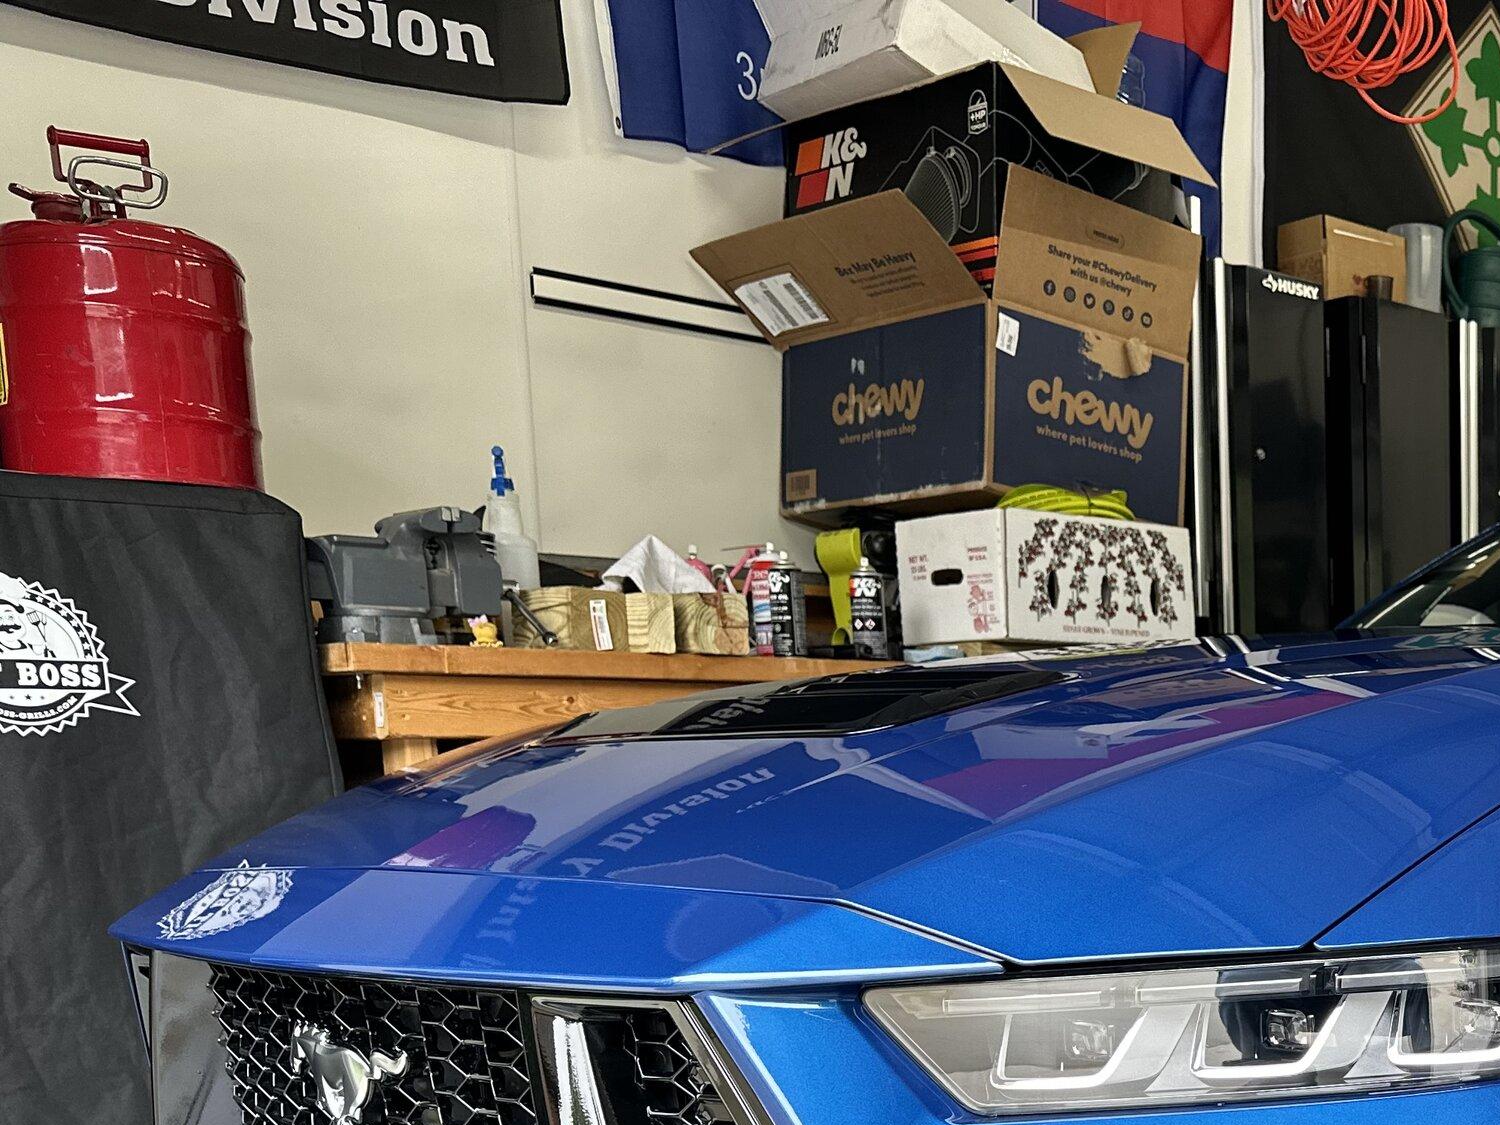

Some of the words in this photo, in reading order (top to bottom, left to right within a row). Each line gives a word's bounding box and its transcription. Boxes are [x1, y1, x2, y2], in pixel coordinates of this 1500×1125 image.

[155, 0, 495, 66] vision
[1048, 244, 1071, 260] Share
[1073, 253, 1091, 267] your
[1092, 260, 1157, 292] #ChewyDelivery
[1070, 266, 1088, 280] with
[1089, 274, 1099, 283] us
[1277, 278, 1319, 300] HUSKY
[832, 378, 925, 426] chewy
[1027, 376, 1153, 449] chewy
[1036, 424, 1068, 442] where
[1069, 434, 1086, 448] pet
[1087, 437, 1118, 455] lovers
[1119, 447, 1143, 464] shop
[15, 662, 102, 688] BOSS
